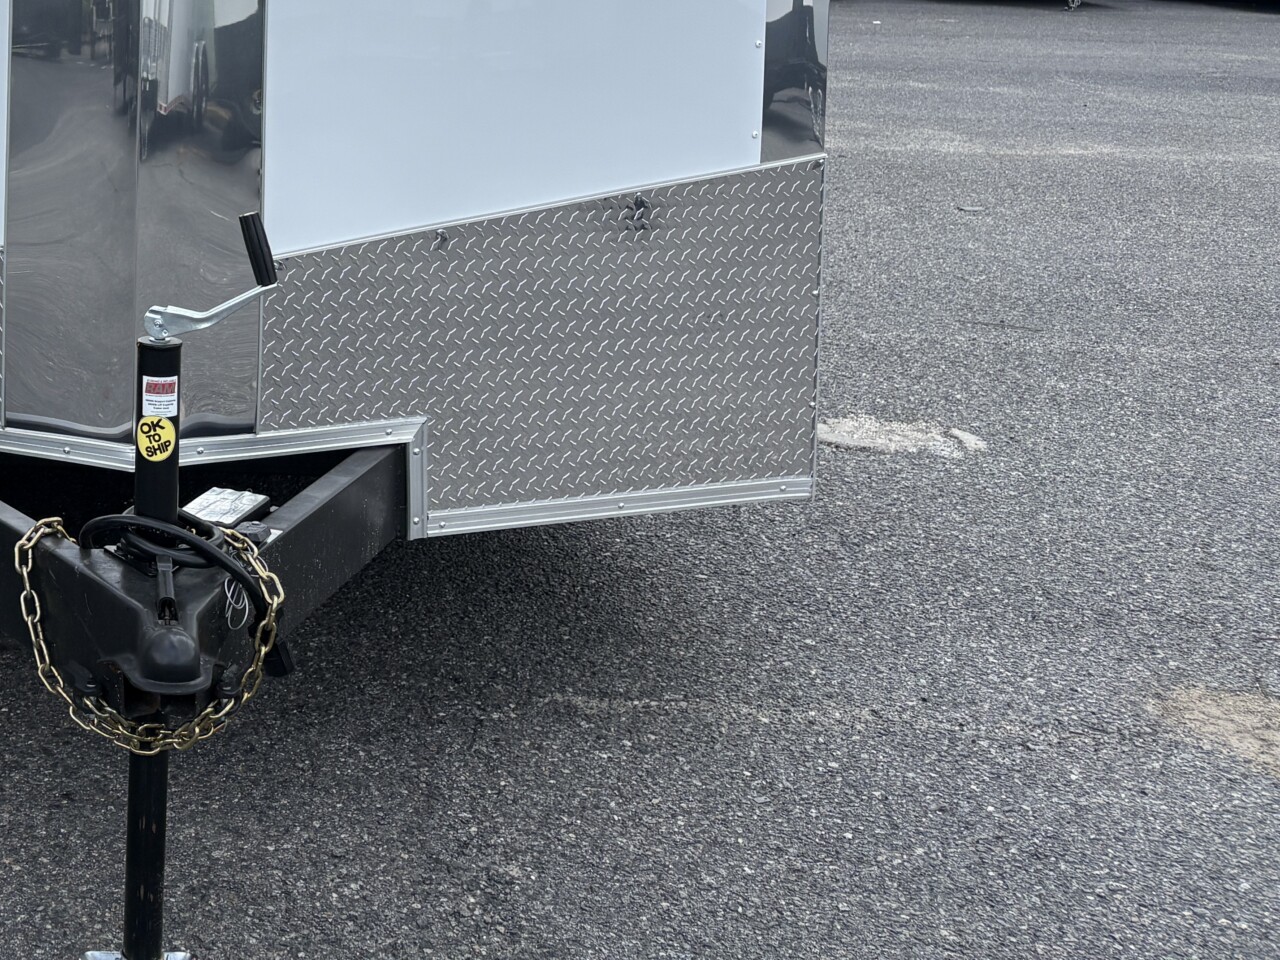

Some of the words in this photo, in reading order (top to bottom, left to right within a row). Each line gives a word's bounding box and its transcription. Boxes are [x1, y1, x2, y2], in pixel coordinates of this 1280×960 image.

[140, 419, 165, 435] OK
[146, 432, 162, 445] TO
[145, 440, 172, 458] SHIP
